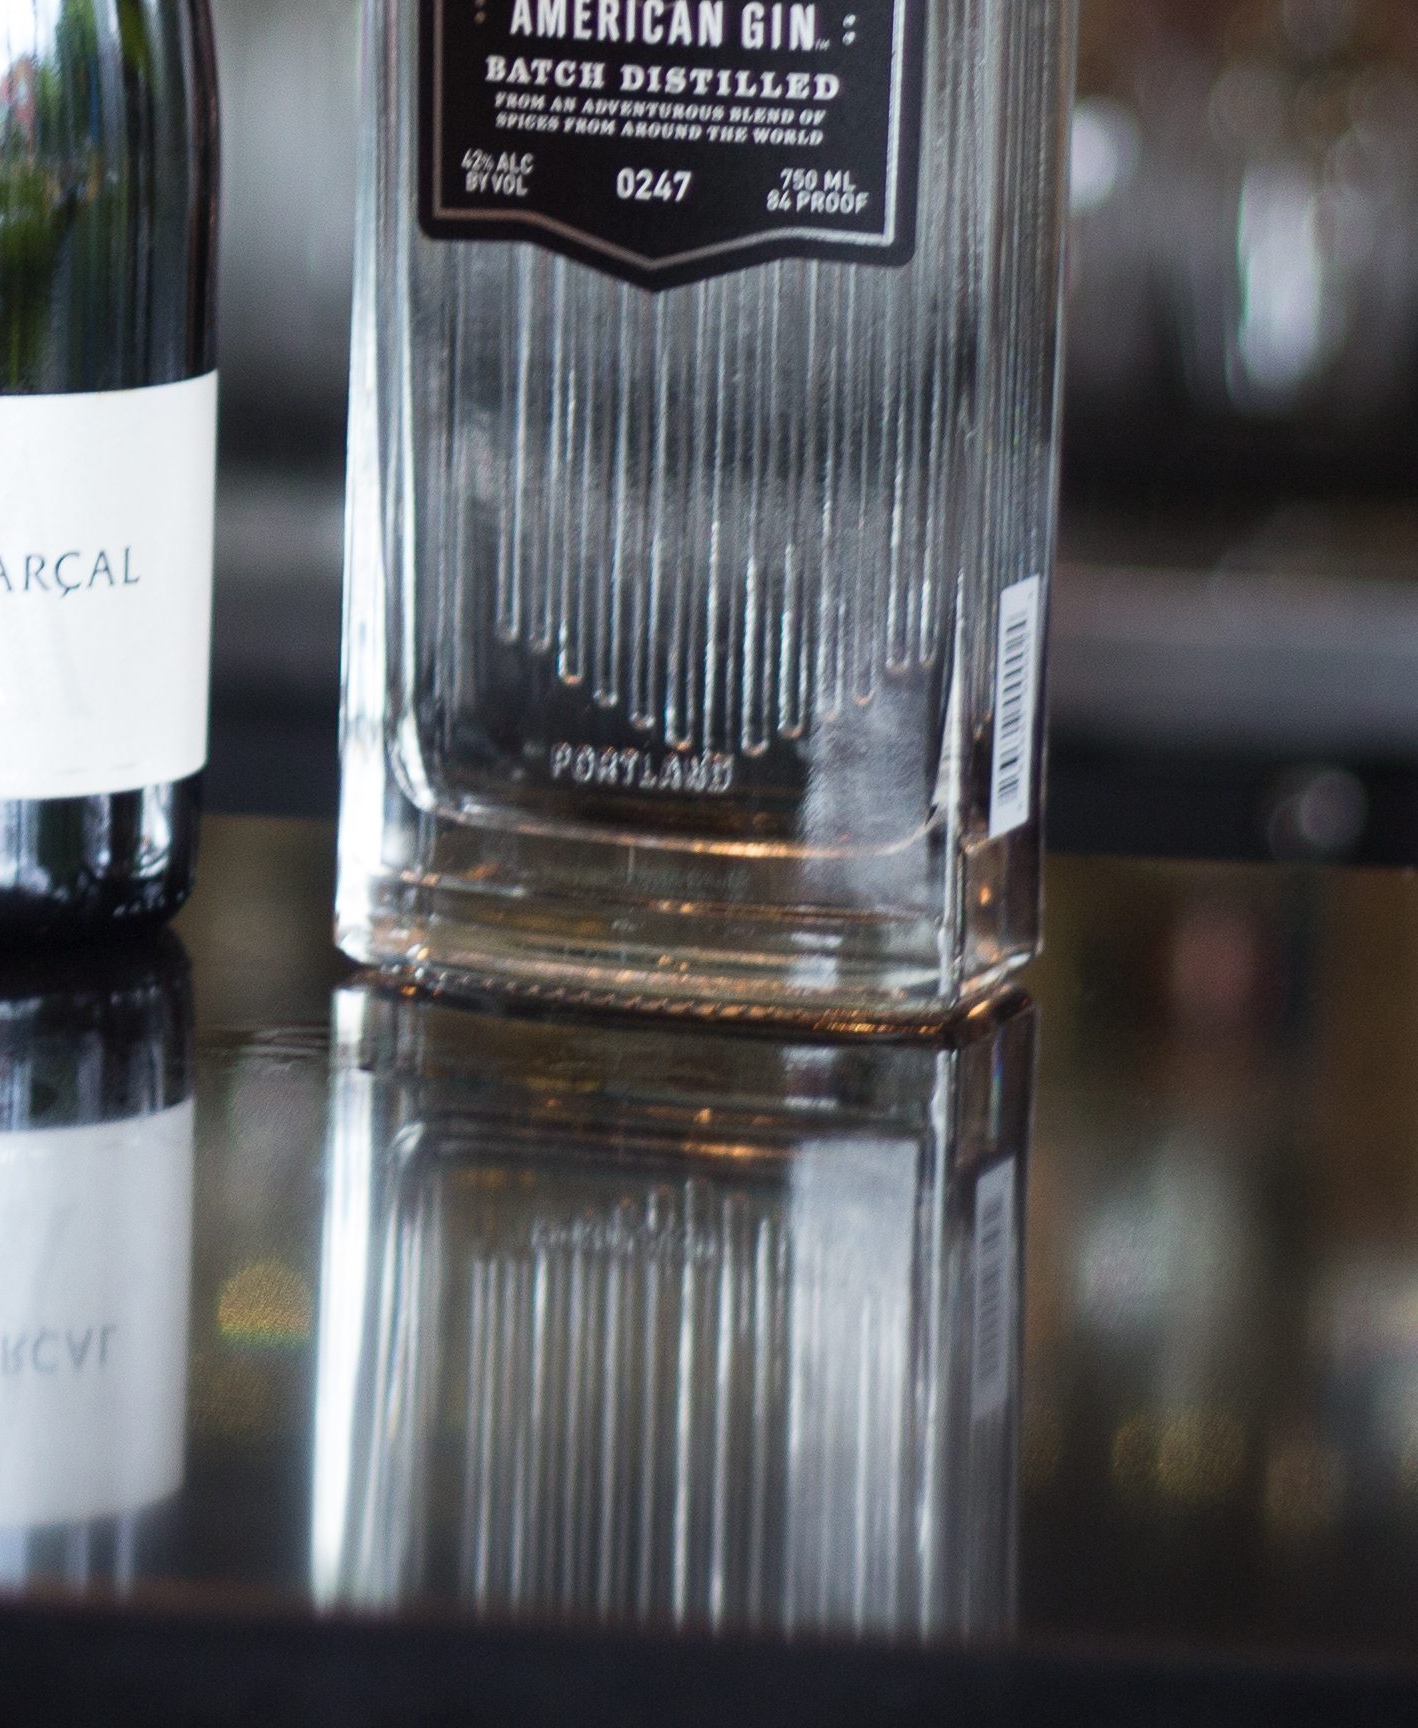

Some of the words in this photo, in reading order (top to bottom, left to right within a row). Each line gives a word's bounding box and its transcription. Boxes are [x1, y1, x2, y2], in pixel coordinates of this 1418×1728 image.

[485, 55, 606, 90] BATCH
[620, 65, 841, 101] DISTILLED
[495, 91, 547, 110] FROM
[550, 95, 577, 113] AN
[582, 97, 727, 122] ADVENTUROUS
[729, 107, 796, 125] BLEND
[799, 109, 827, 126] OF
[495, 111, 560, 132] SPICES
[563, 117, 617, 137] FROM
[620, 121, 703, 141] AROUND
[706, 125, 749, 144] THE
[752, 127, 825, 147] WORLD
[496, 151, 535, 176] ALC
[780, 167, 819, 191] 750
[823, 169, 857, 193] ML
[465, 171, 490, 193] BY
[491, 171, 529, 197] VOL
[616, 167, 693, 203] 0247
[766, 188, 792, 212] 84
[795, 190, 870, 214] PROOF
[549, 741, 734, 794] PORTLAND
